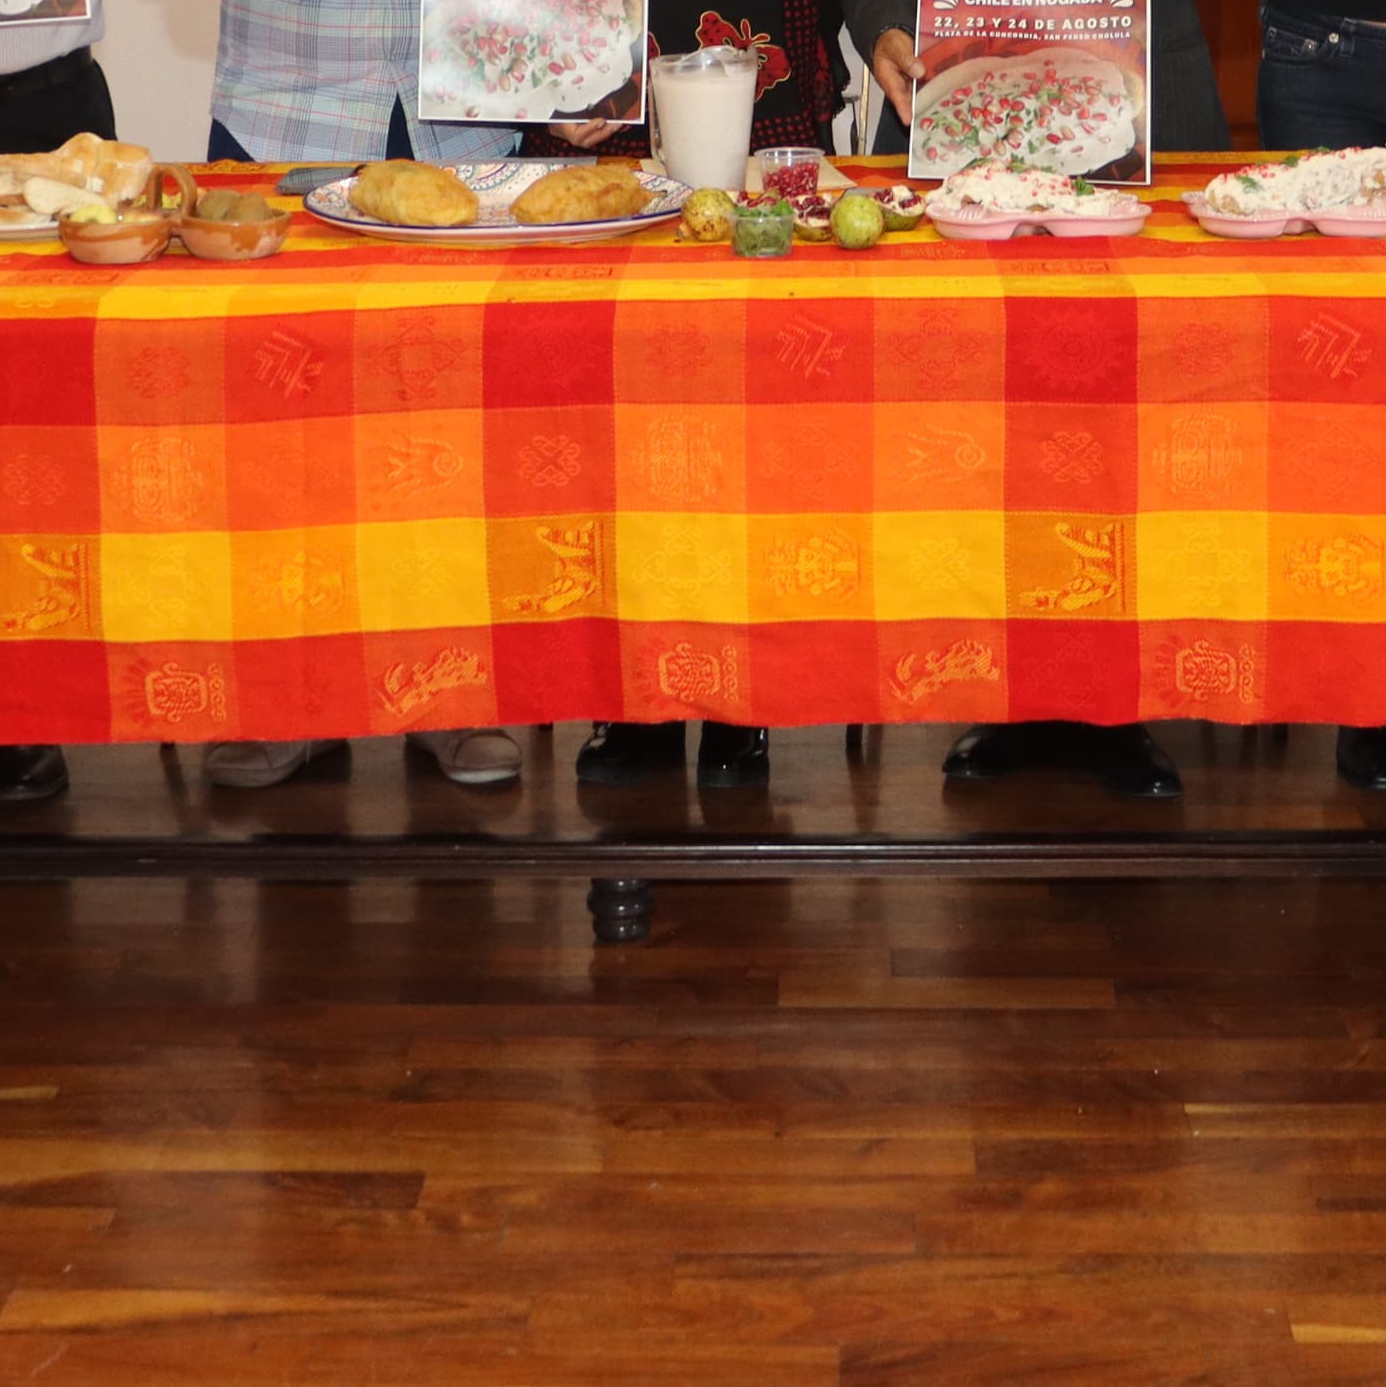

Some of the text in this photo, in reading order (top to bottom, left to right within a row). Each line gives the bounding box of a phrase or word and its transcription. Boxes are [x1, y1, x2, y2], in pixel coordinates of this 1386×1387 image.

[934, 16, 1132, 30] 22, 23 Y 24 DE AGOSTO
